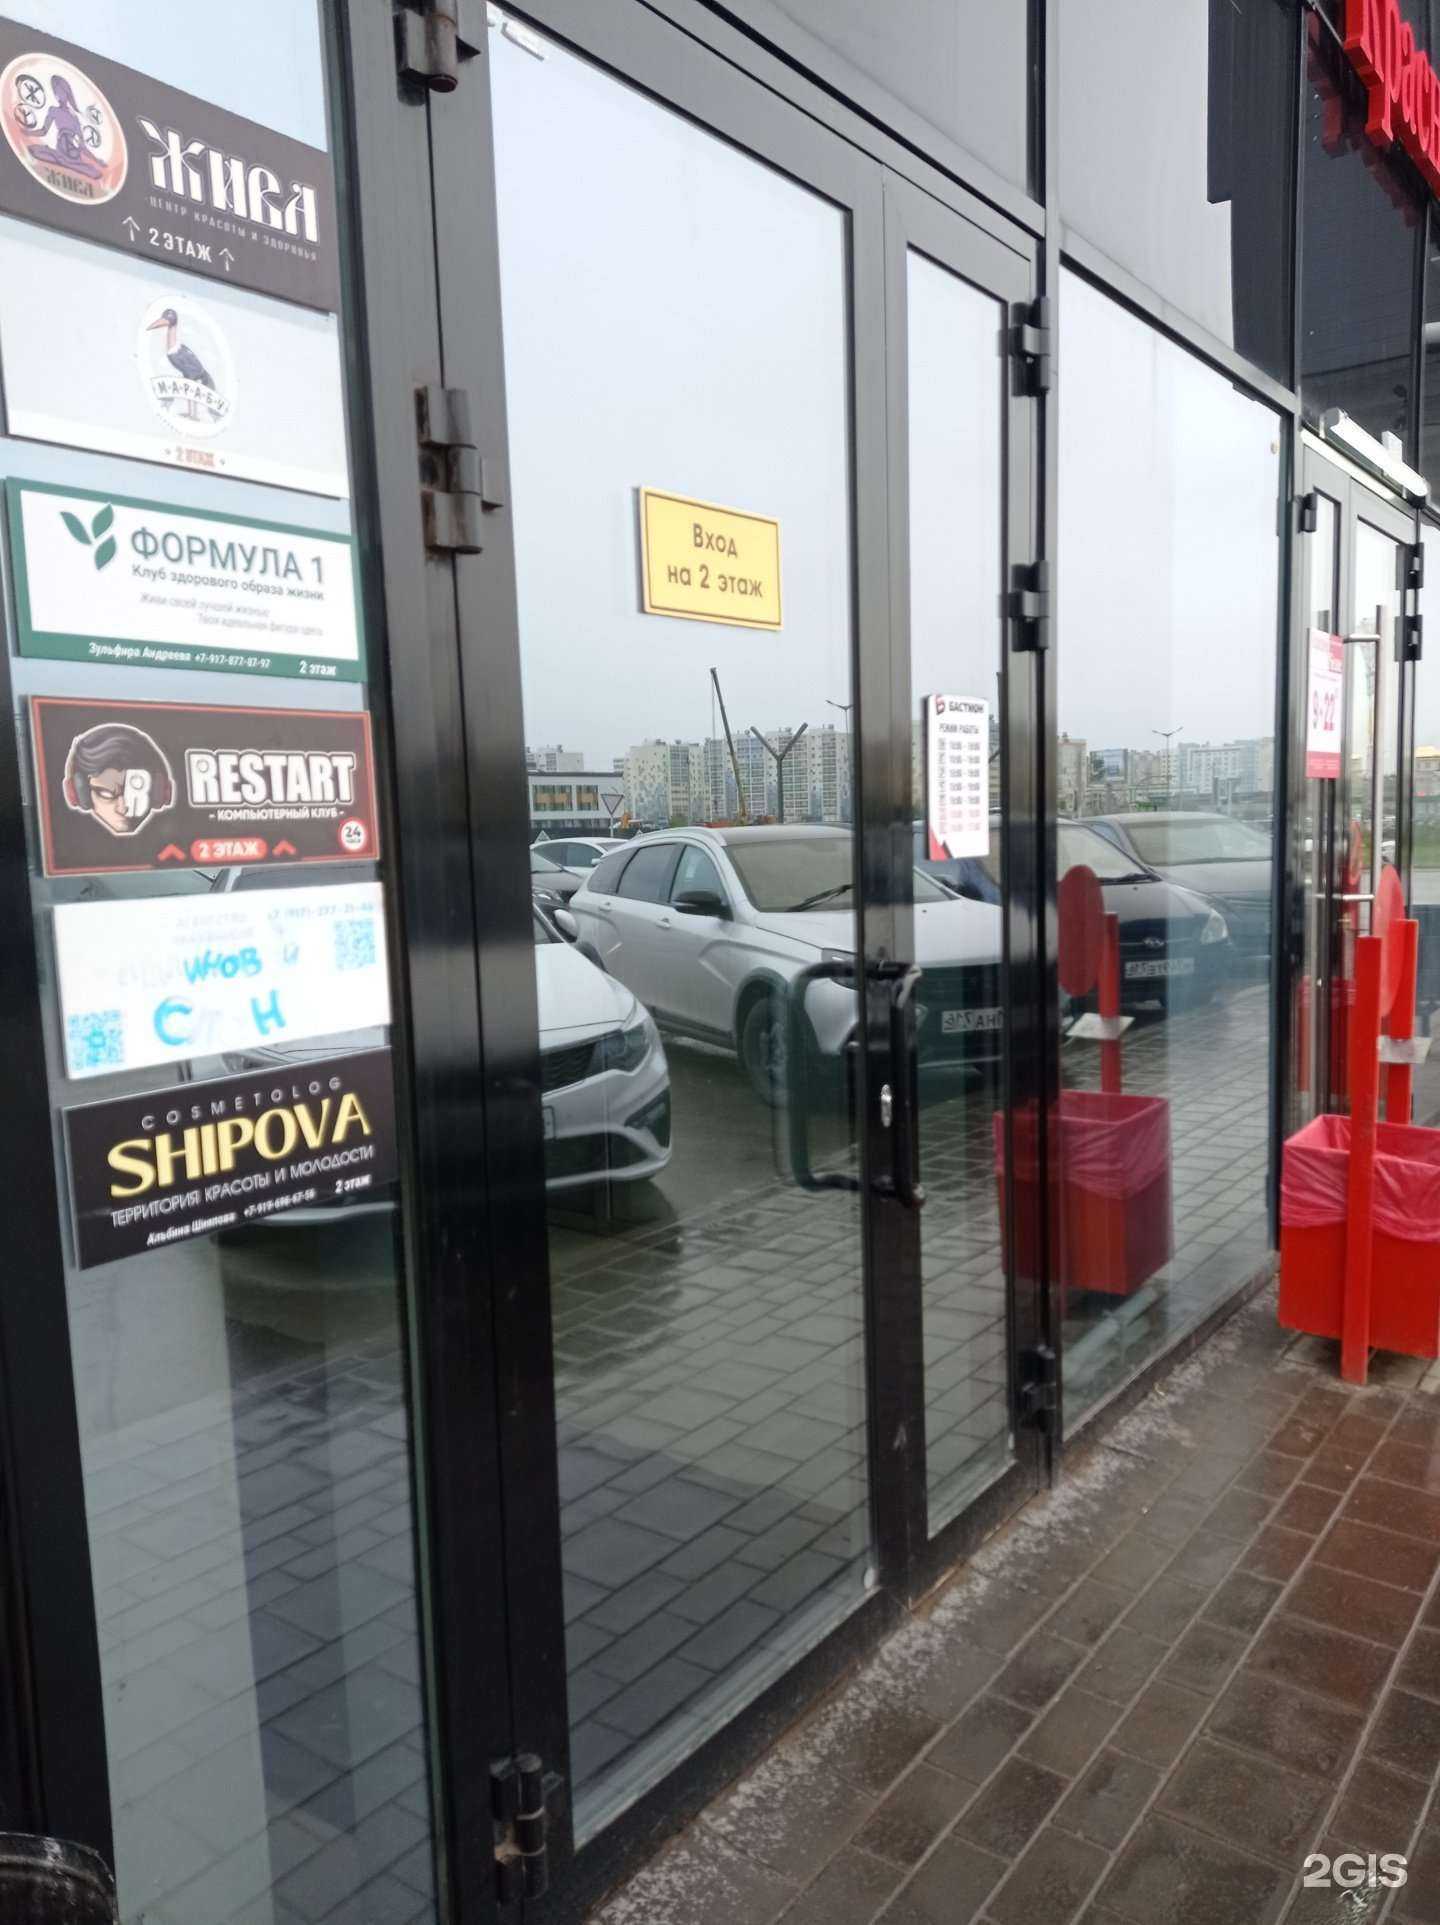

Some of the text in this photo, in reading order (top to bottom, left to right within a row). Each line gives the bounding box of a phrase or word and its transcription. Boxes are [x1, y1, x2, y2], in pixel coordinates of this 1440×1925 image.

[139, 119, 318, 243] ЖИВА
[130, 526, 324, 585] ФОРМУЛА 1
[692, 522, 738, 558] Вход
[131, 563, 325, 602] Клуб здорового образа жизни
[667, 563, 764, 599] на 2 этаж
[299, 660, 308, 674] 2
[948, 700, 985, 714] БАСТИОН
[188, 751, 355, 805] RESTART
[217, 806, 338, 822] КОМПЬЮТЕРНЫЙ КЛУБ
[344, 825, 362, 838] 24
[199, 841, 259, 859] 2 ЭТАЖ
[141, 1076, 342, 1131] COSMETOLOG
[107, 1091, 372, 1198] SHIPOVA
[110, 1144, 375, 1229] ТЕРРИТОРИЯ КРАСОТЫ И МОЛОДОСТИ
